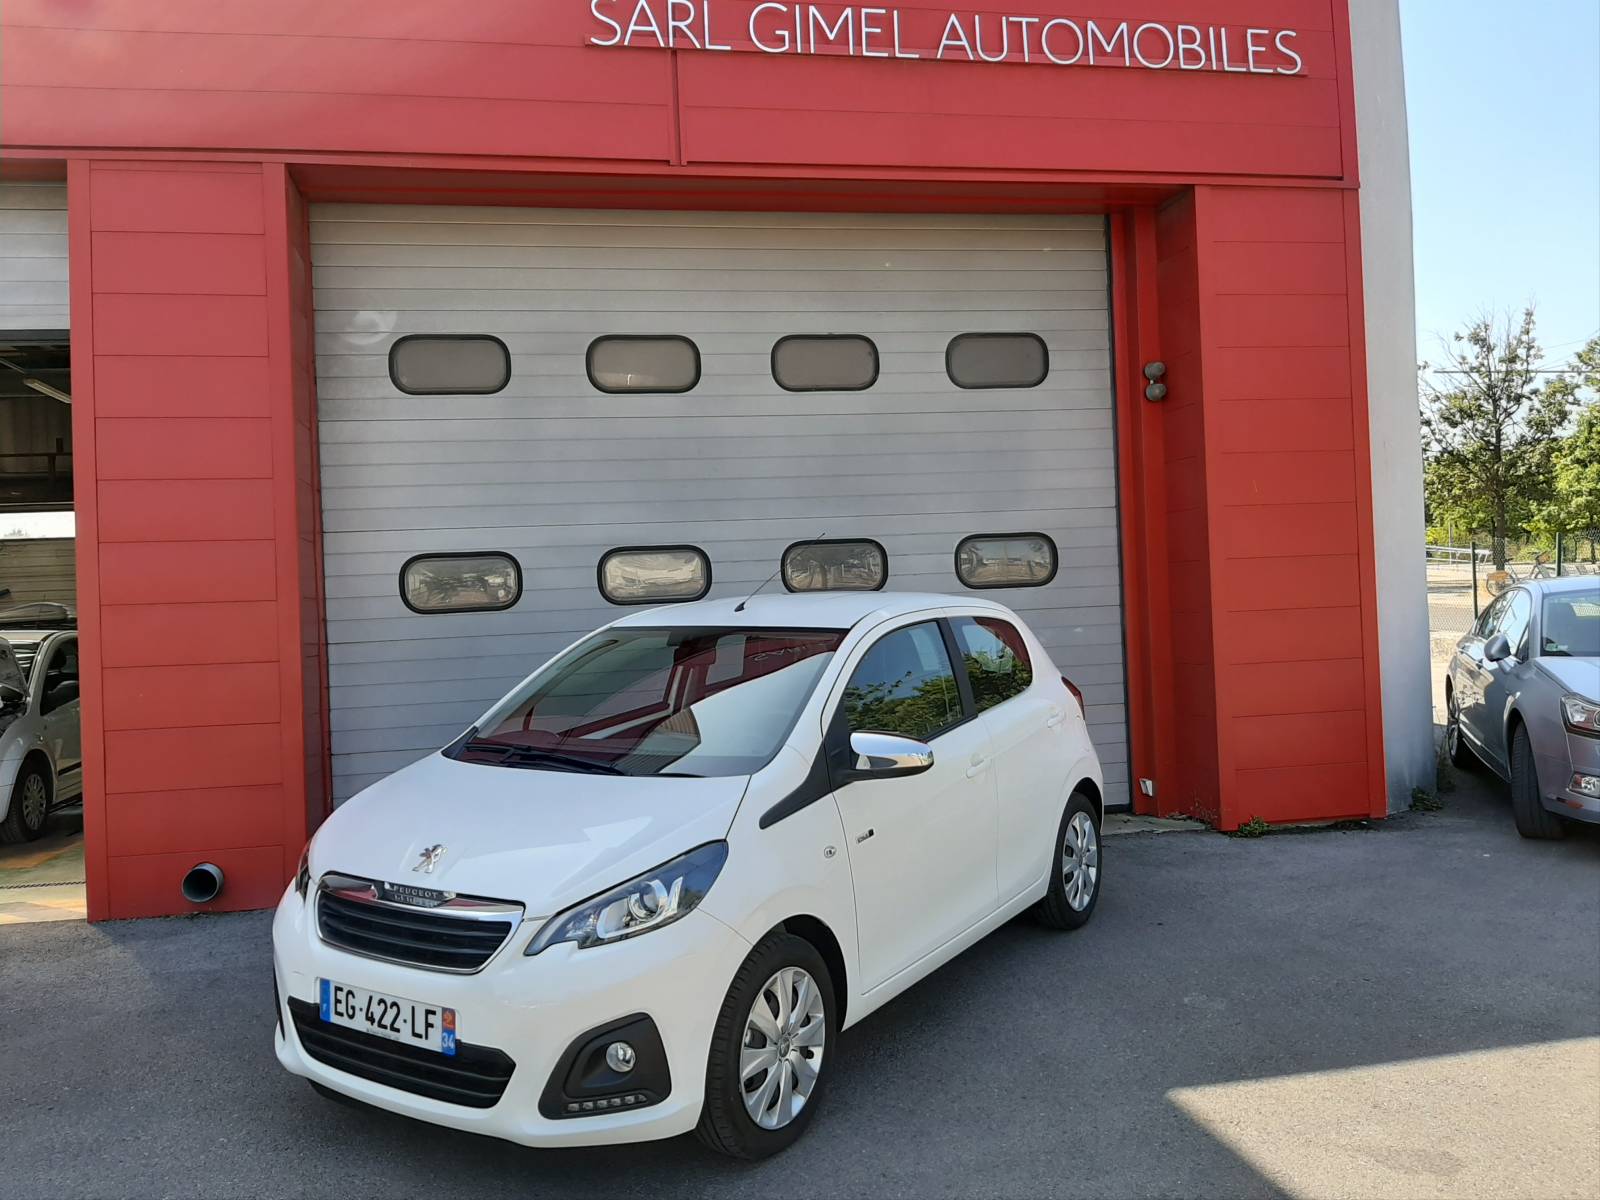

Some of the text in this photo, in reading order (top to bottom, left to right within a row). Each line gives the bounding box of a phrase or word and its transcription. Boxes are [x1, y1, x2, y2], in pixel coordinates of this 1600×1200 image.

[589, 0, 1302, 76] SARL GIMEL AUTOMOBILES
[393, 884, 439, 899] PEUGEOT
[442, 1032, 456, 1048] 34
